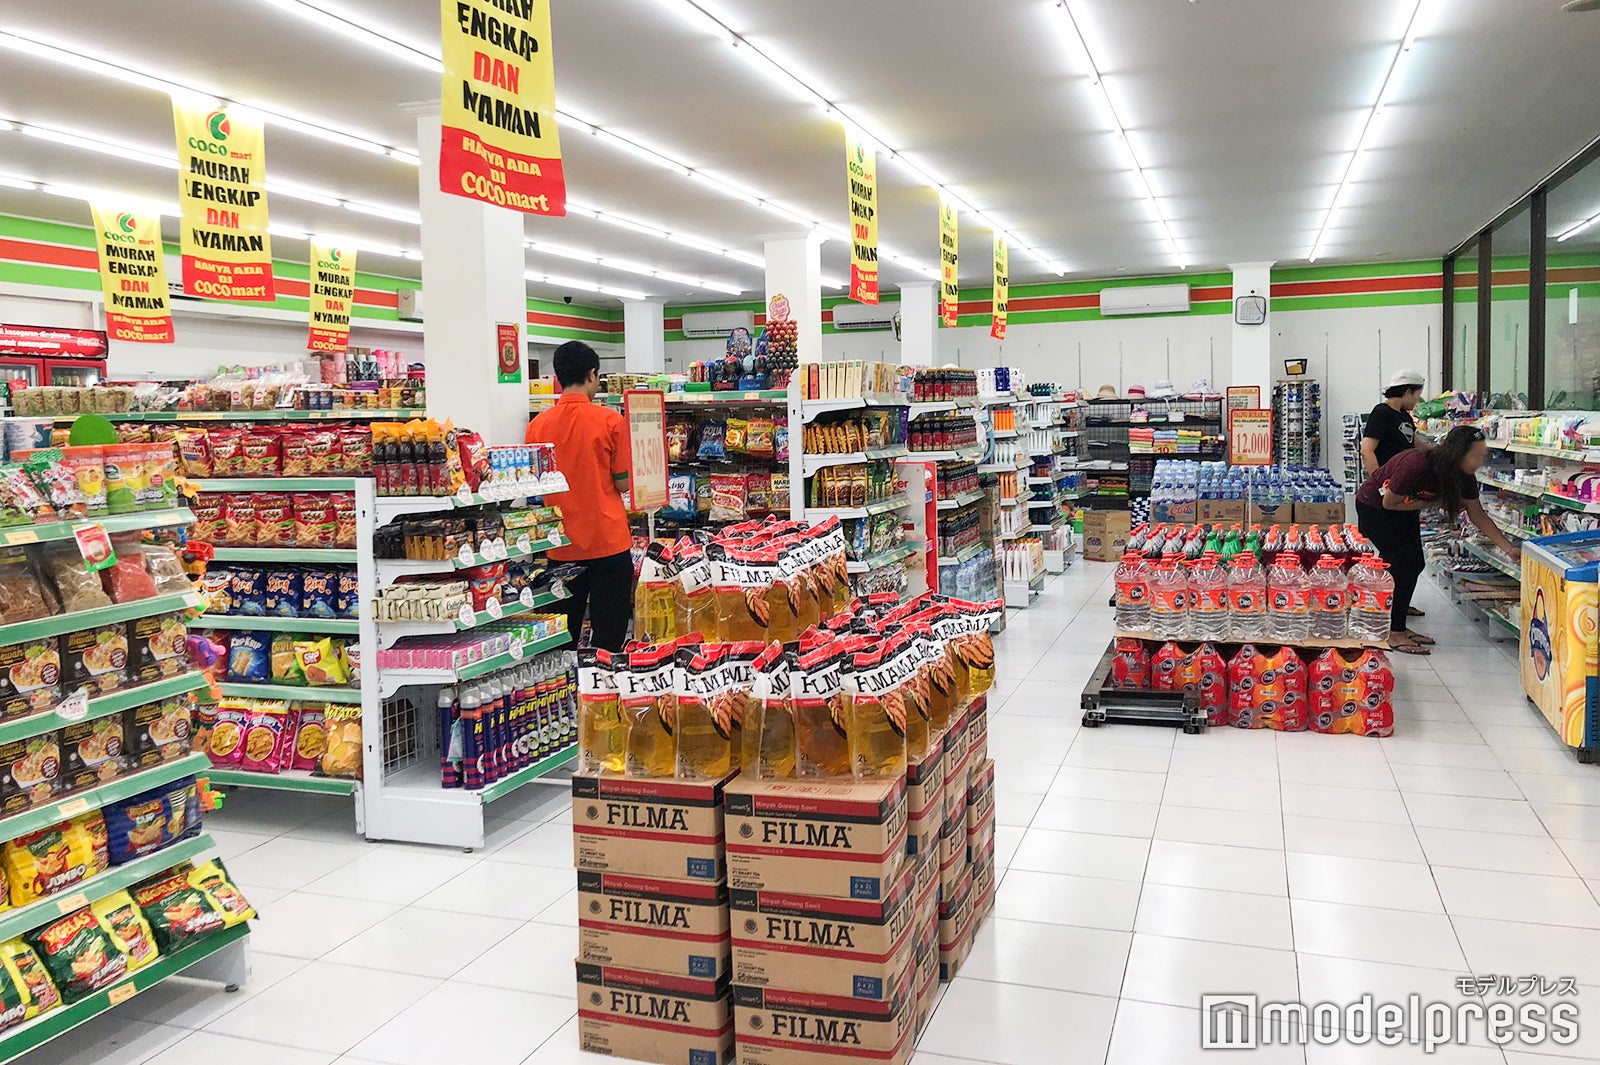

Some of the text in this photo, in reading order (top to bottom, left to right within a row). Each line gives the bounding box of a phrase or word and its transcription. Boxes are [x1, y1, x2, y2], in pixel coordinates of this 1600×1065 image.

[474, 51, 519, 95] DAN
[189, 137, 227, 156] COCO
[190, 156, 249, 184] MURAH
[507, 158, 542, 176] ADA
[207, 208, 239, 229] DAN
[192, 228, 263, 251] NYAMAN
[106, 244, 155, 261] MURAH
[121, 280, 149, 293] DAN
[318, 271, 350, 286] MURAH
[314, 284, 352, 299] LENGKAP
[325, 300, 344, 311] DAN
[1237, 433, 1269, 454] 12.000
[268, 577, 290, 594] Ring
[304, 576, 327, 593] Ring
[607, 804, 688, 831] FILMA
[762, 821, 852, 849] FILMA
[46, 864, 86, 889] JUMBO
[609, 899, 690, 929] FILMA
[766, 917, 855, 948] FILMA
[610, 991, 691, 1023] FILMA
[772, 1014, 861, 1045] FILMA
